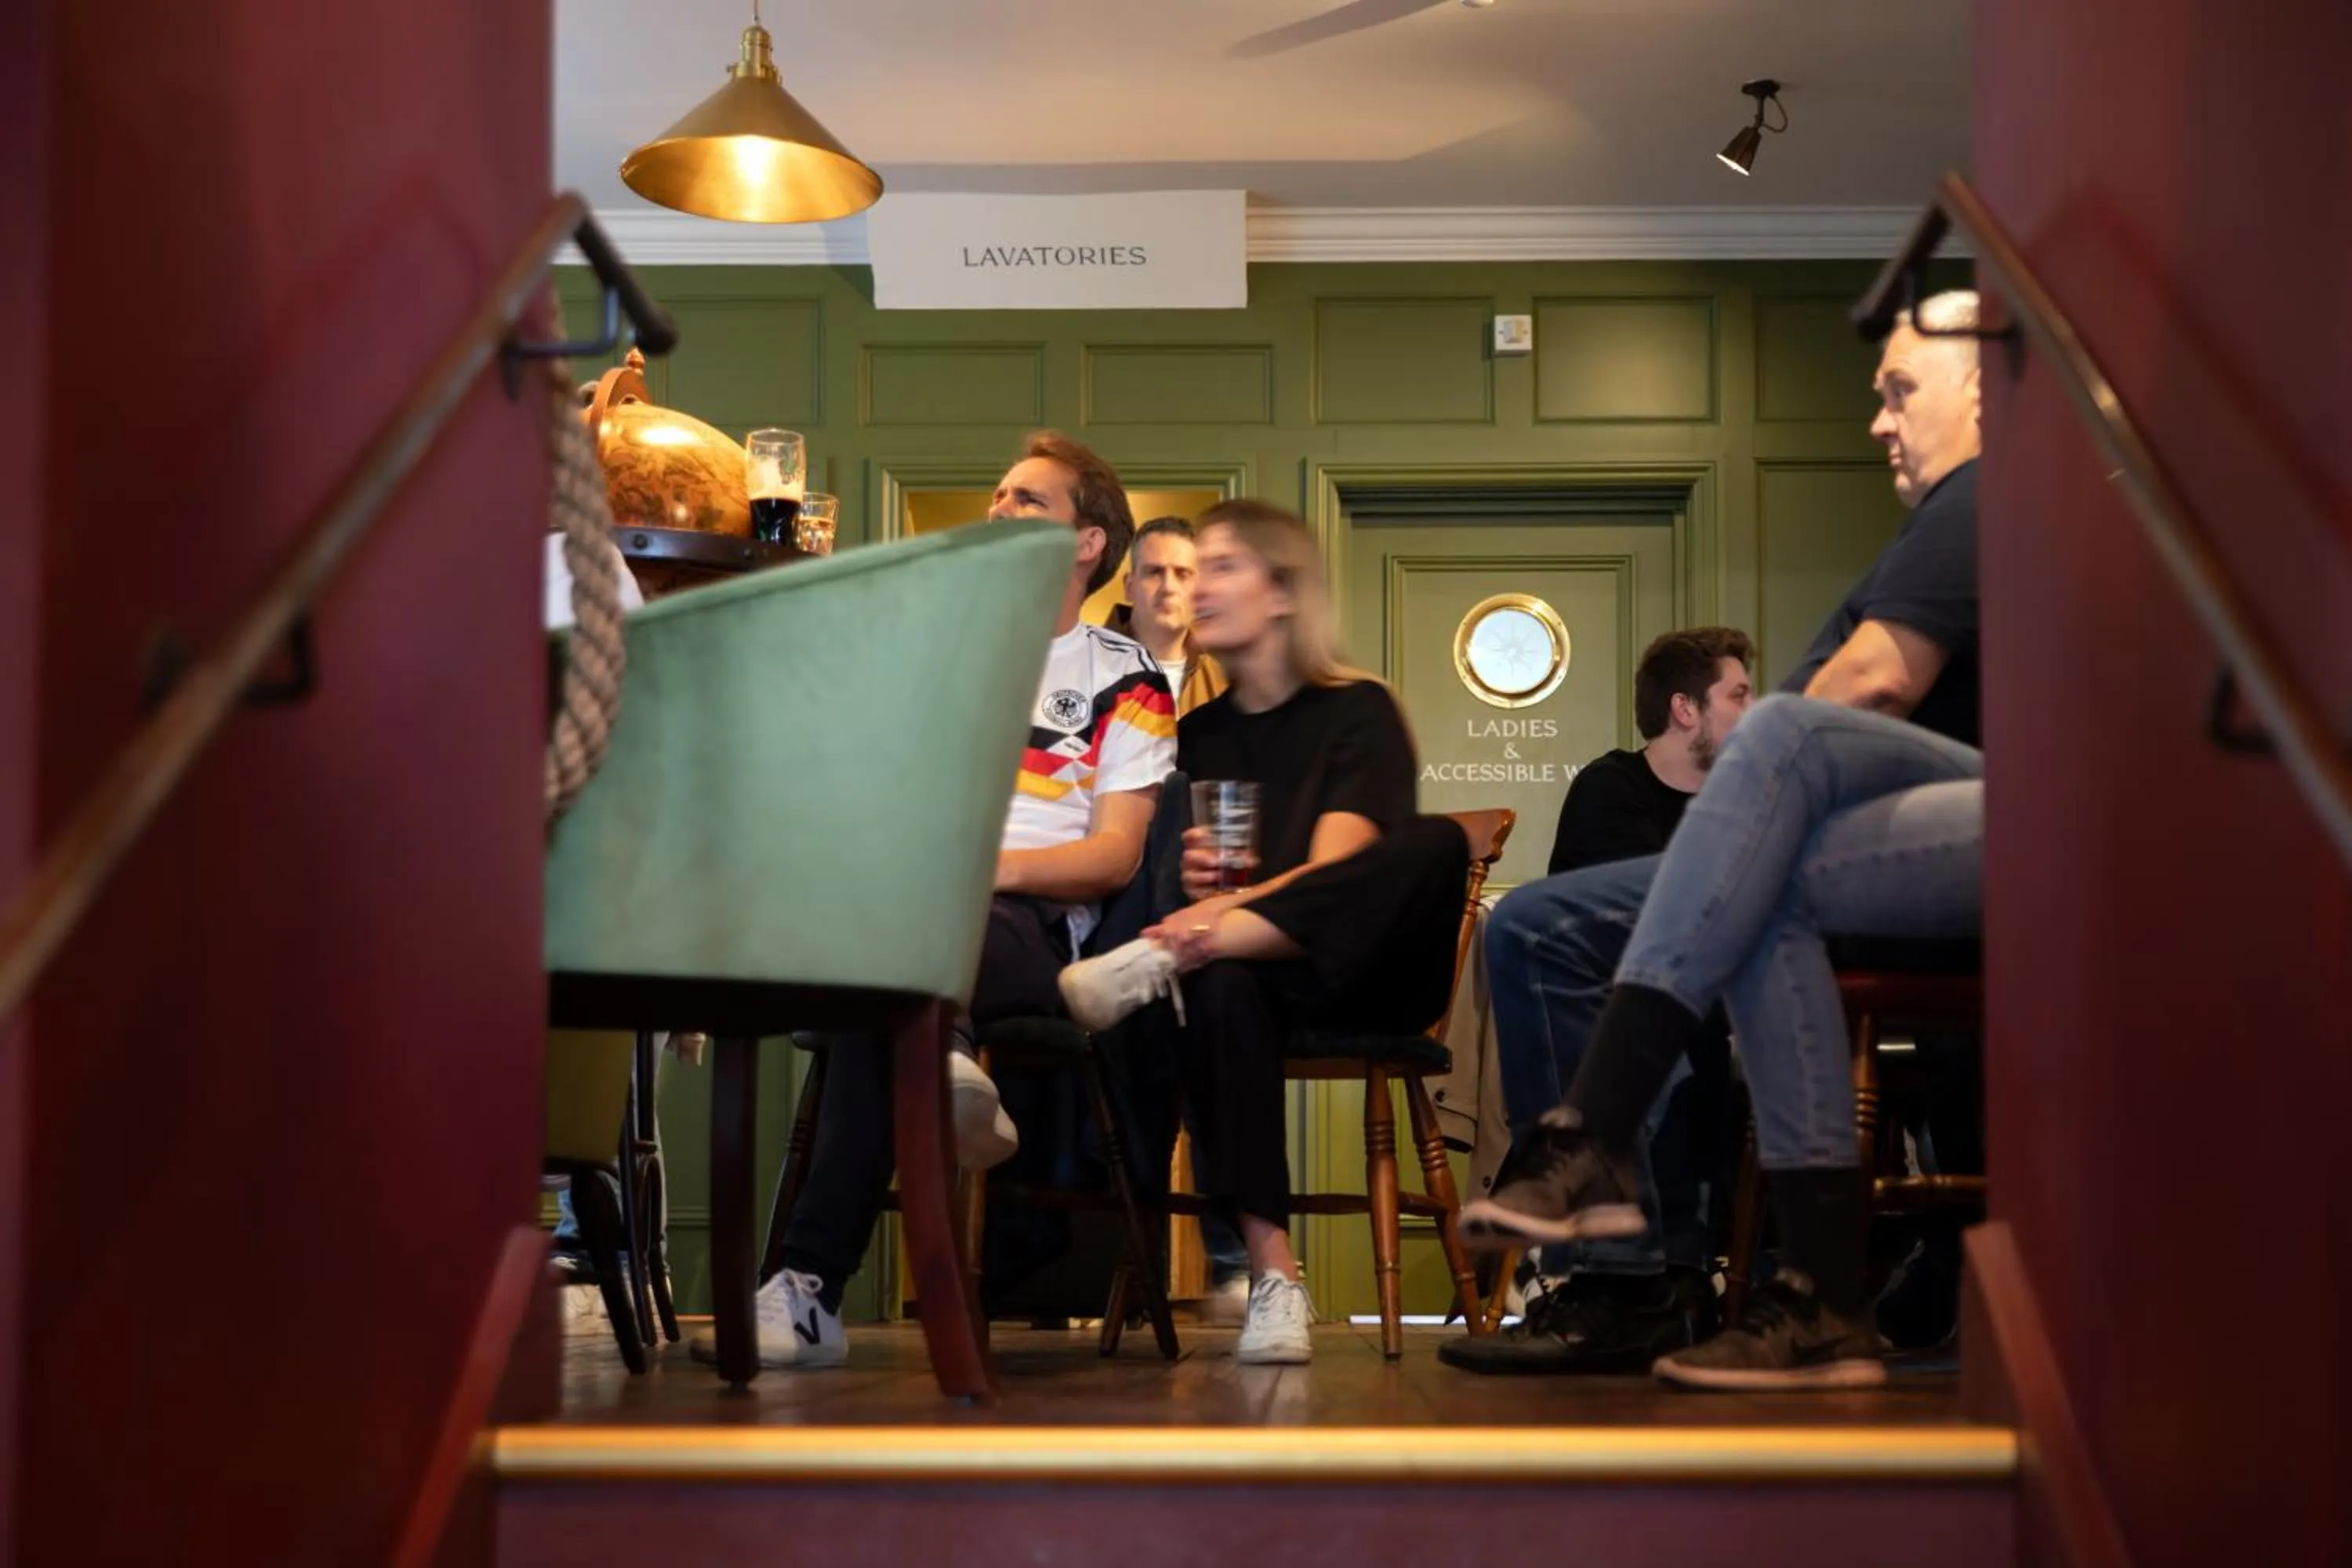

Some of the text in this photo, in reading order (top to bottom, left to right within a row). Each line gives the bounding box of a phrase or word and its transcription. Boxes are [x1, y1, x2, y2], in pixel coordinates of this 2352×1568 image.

[963, 246, 1147, 267] LAVATORIES
[1467, 719, 1558, 738] LADIES
[1504, 742, 1521, 759] &
[1420, 764, 1586, 783] ACCESSIBLE W
